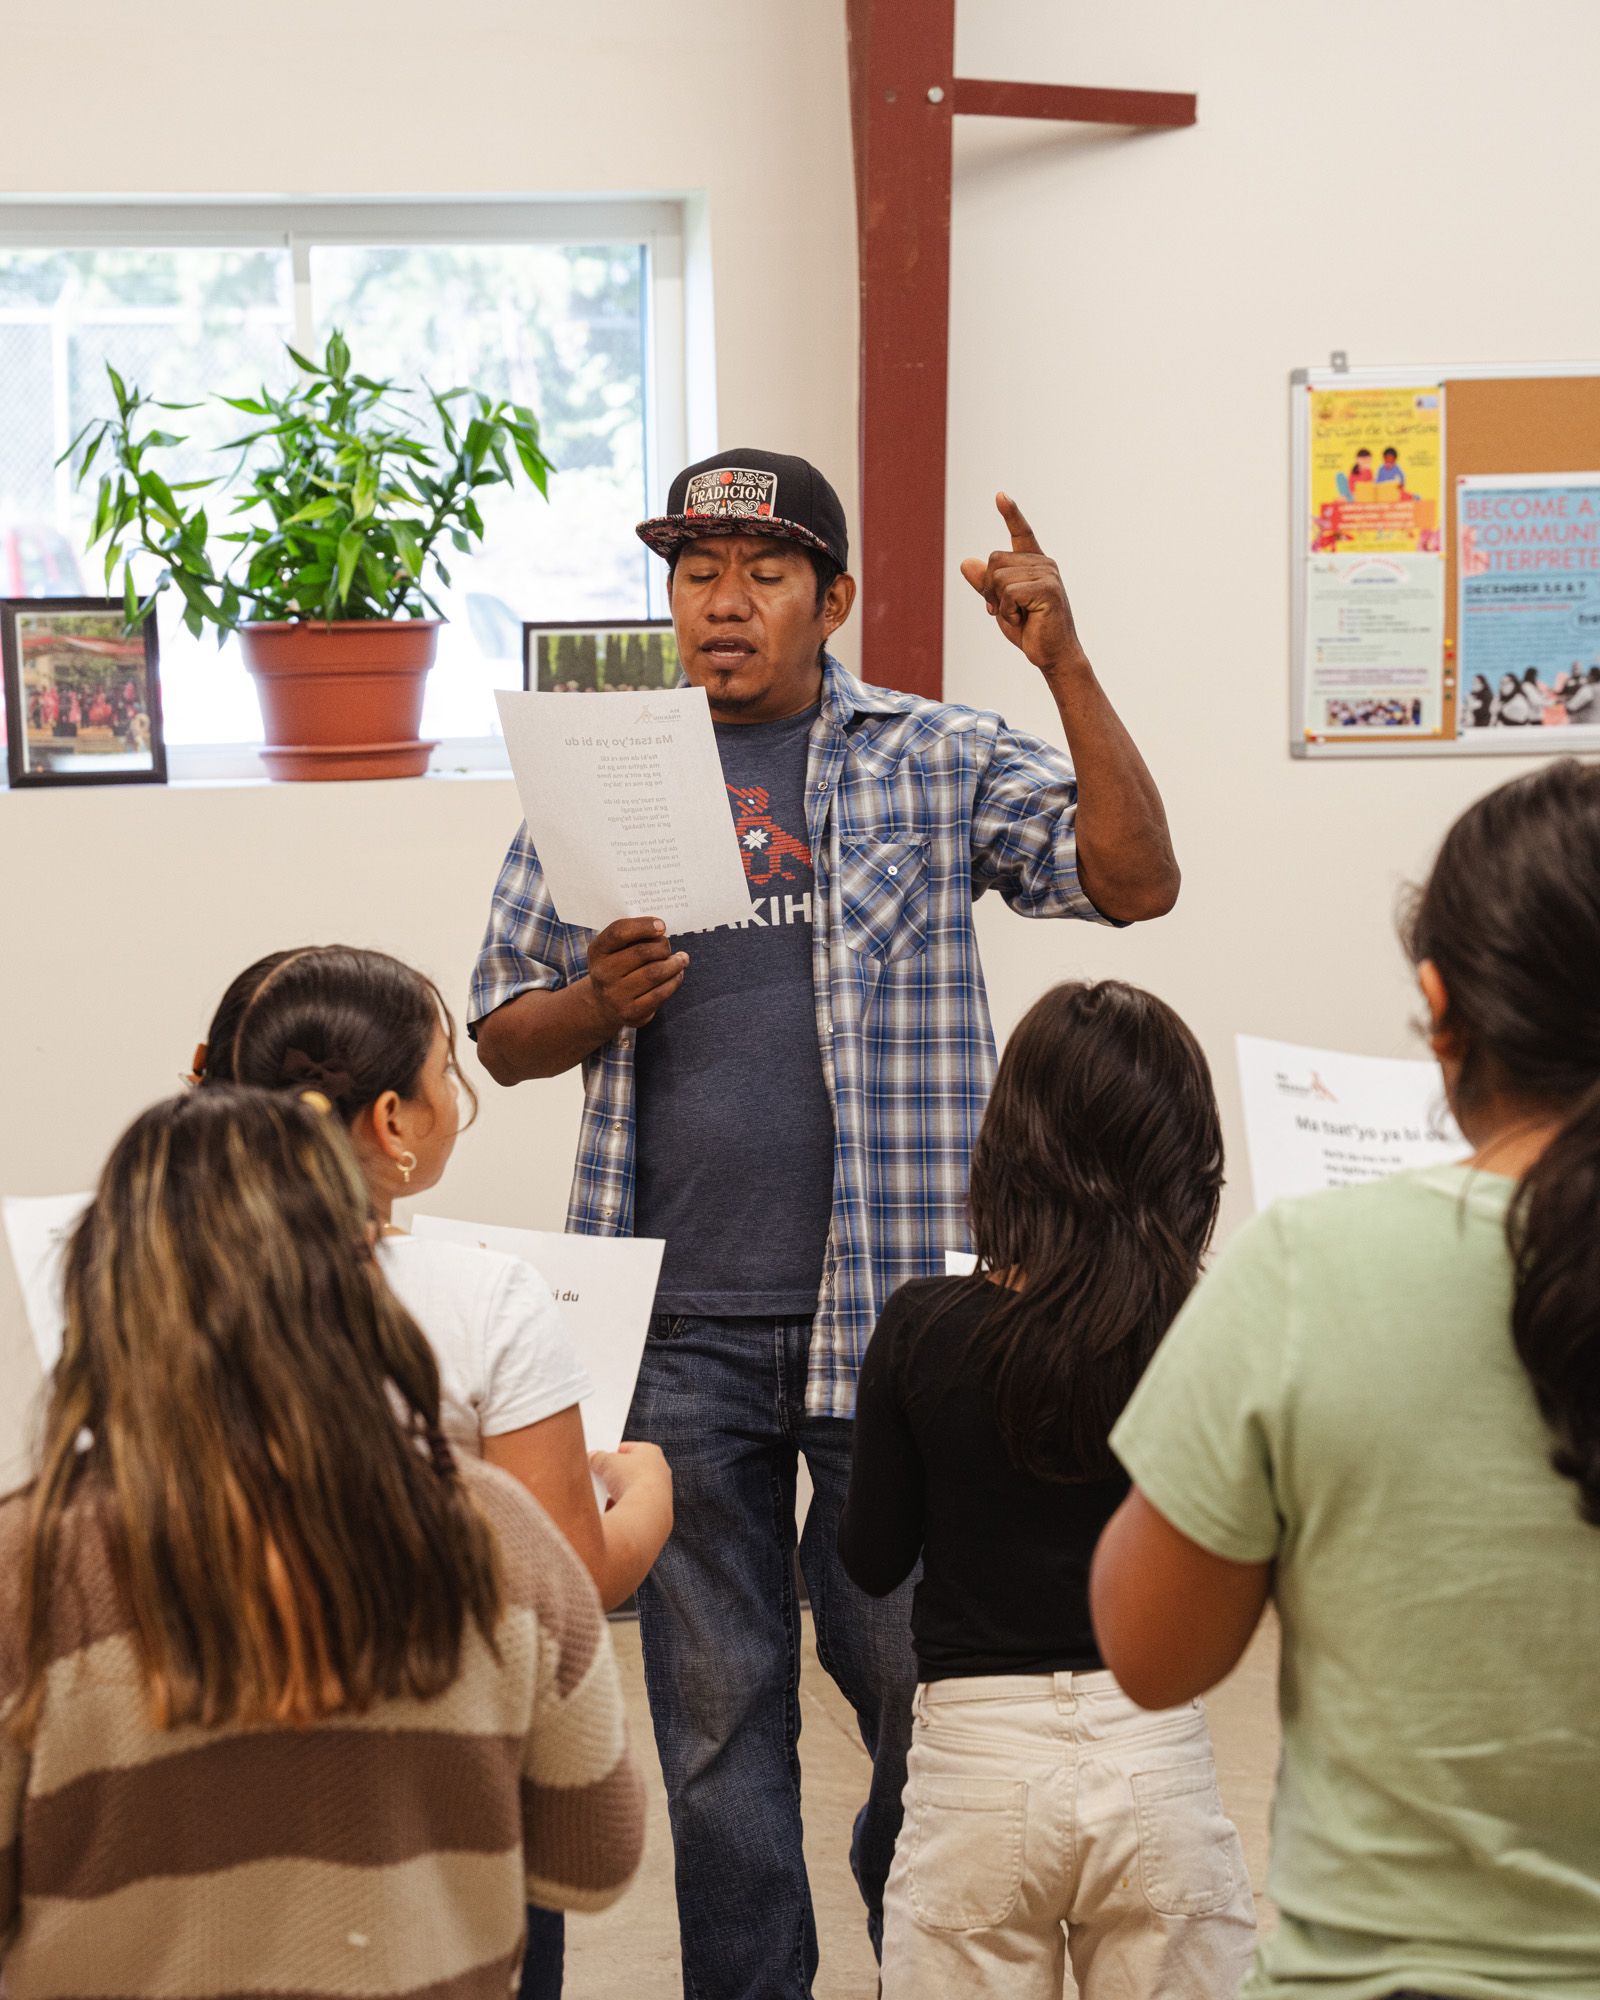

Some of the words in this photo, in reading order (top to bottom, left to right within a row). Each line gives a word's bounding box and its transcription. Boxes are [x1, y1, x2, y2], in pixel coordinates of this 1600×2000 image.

[691, 485, 768, 505] TRADICION
[1466, 496, 1568, 520] BECOME
[1577, 497, 1594, 515] A
[1463, 522, 1600, 546] COMMUNI
[1465, 582, 1539, 595] DECEMBER
[1295, 1115, 1318, 1131] Ma
[1382, 1129, 1402, 1143] ya
[1404, 1125, 1422, 1141] bi
[562, 1290, 580, 1302] du
